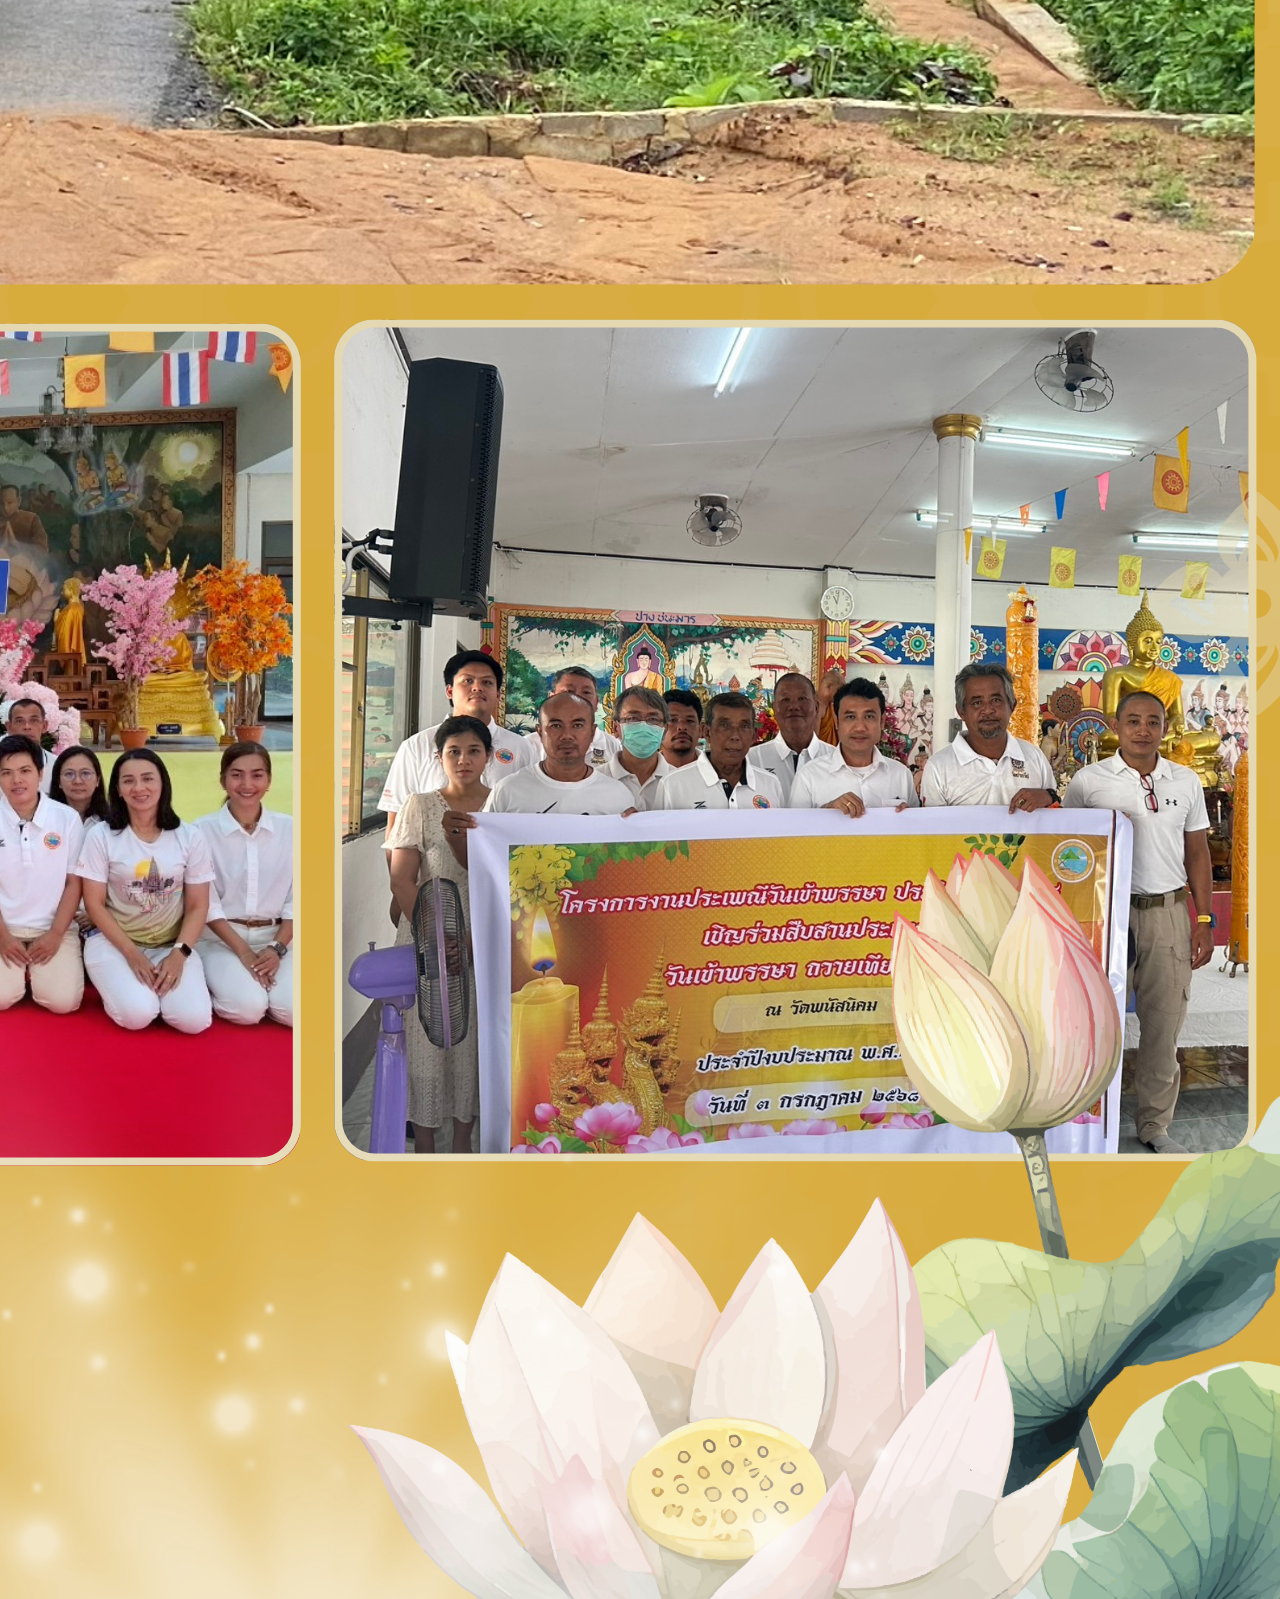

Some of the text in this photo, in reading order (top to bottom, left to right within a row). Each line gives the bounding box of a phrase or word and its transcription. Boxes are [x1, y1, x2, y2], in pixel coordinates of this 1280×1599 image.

[559, 882, 887, 916] โครงการงานประเพณีวันเข้าพรรษา
[664, 959, 798, 989] วันเข้าพรรษา
[765, 997, 878, 1017] ณ วัดพนัสนิคม
[697, 1044, 853, 1072] ประจำปีงบประมาณ
[708, 1088, 919, 1115] วันที่ ๓ กรกฎาคม ๒๕๖๘
